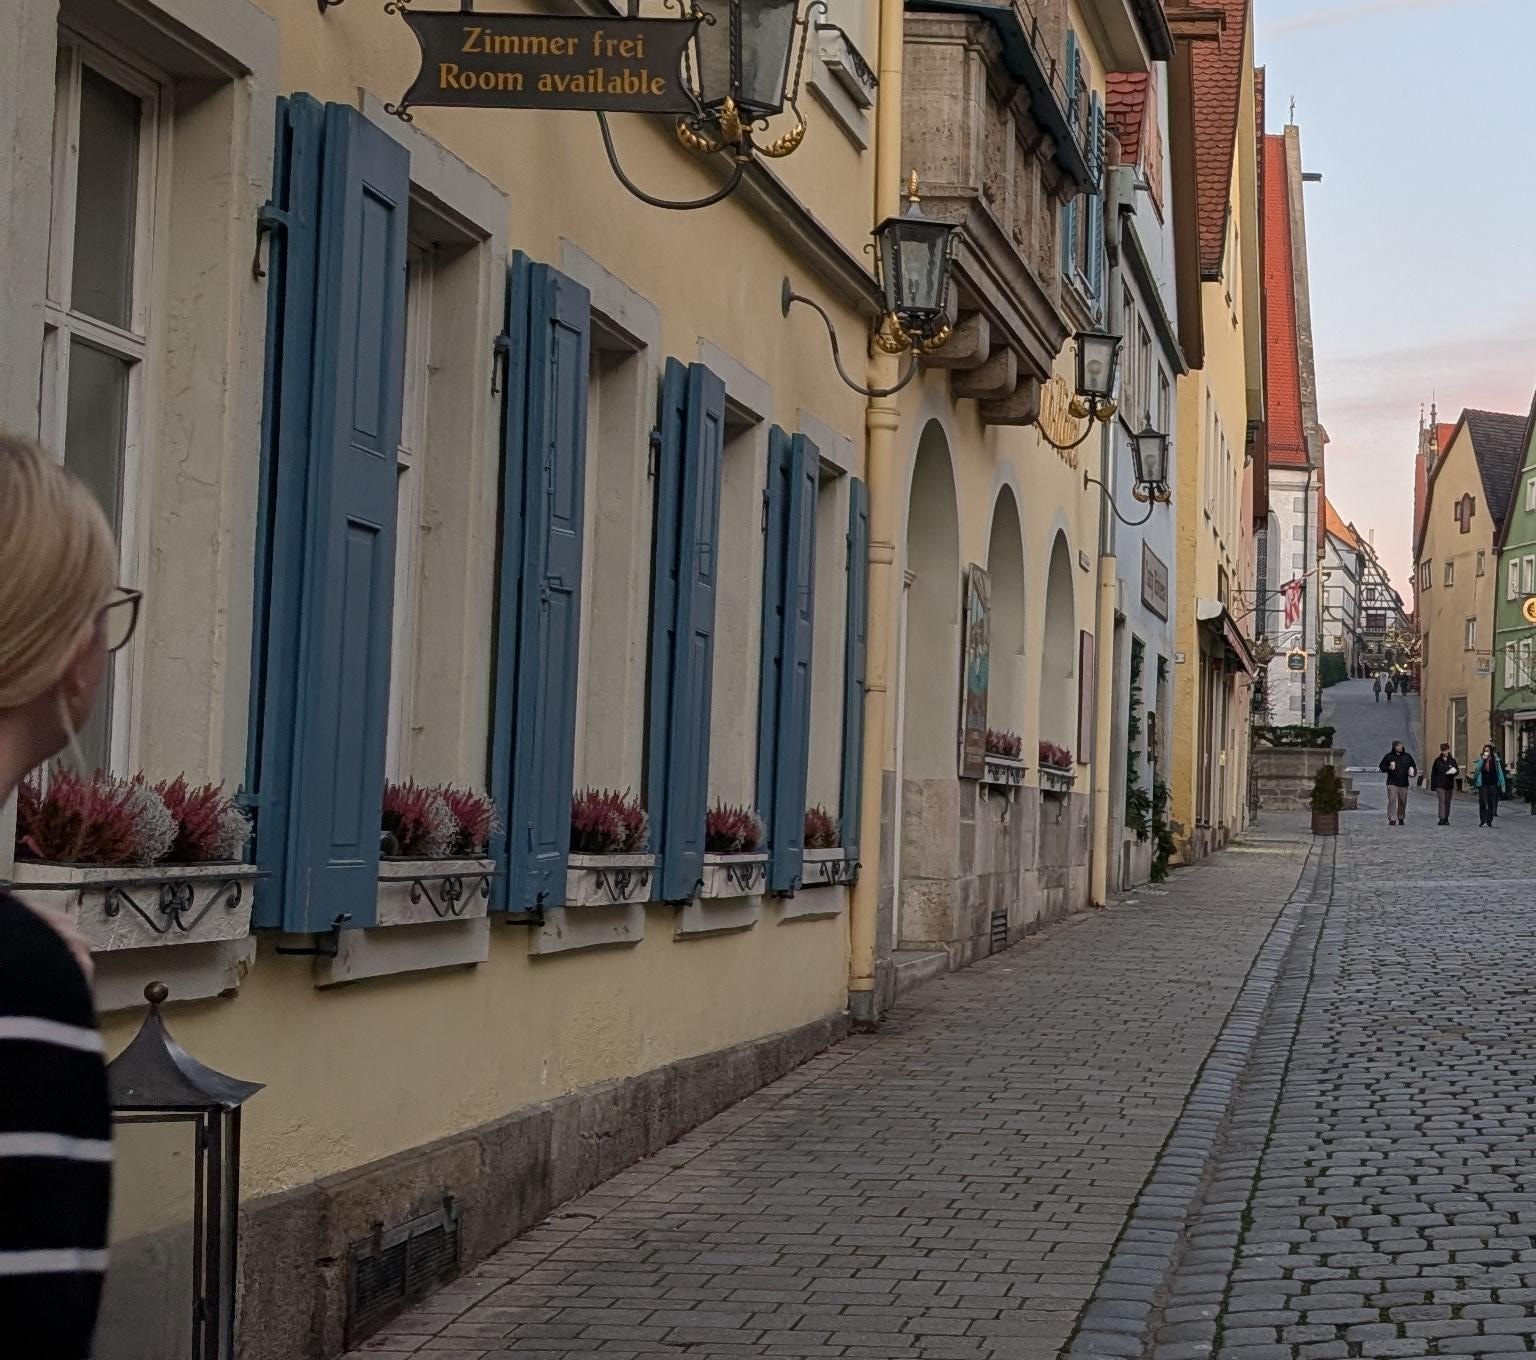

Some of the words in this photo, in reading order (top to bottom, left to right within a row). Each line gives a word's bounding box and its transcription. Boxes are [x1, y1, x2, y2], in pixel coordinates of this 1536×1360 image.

[461, 27, 578, 56] Zimmer
[592, 29, 645, 58] frei
[439, 63, 523, 91] Room
[538, 67, 666, 95] available
